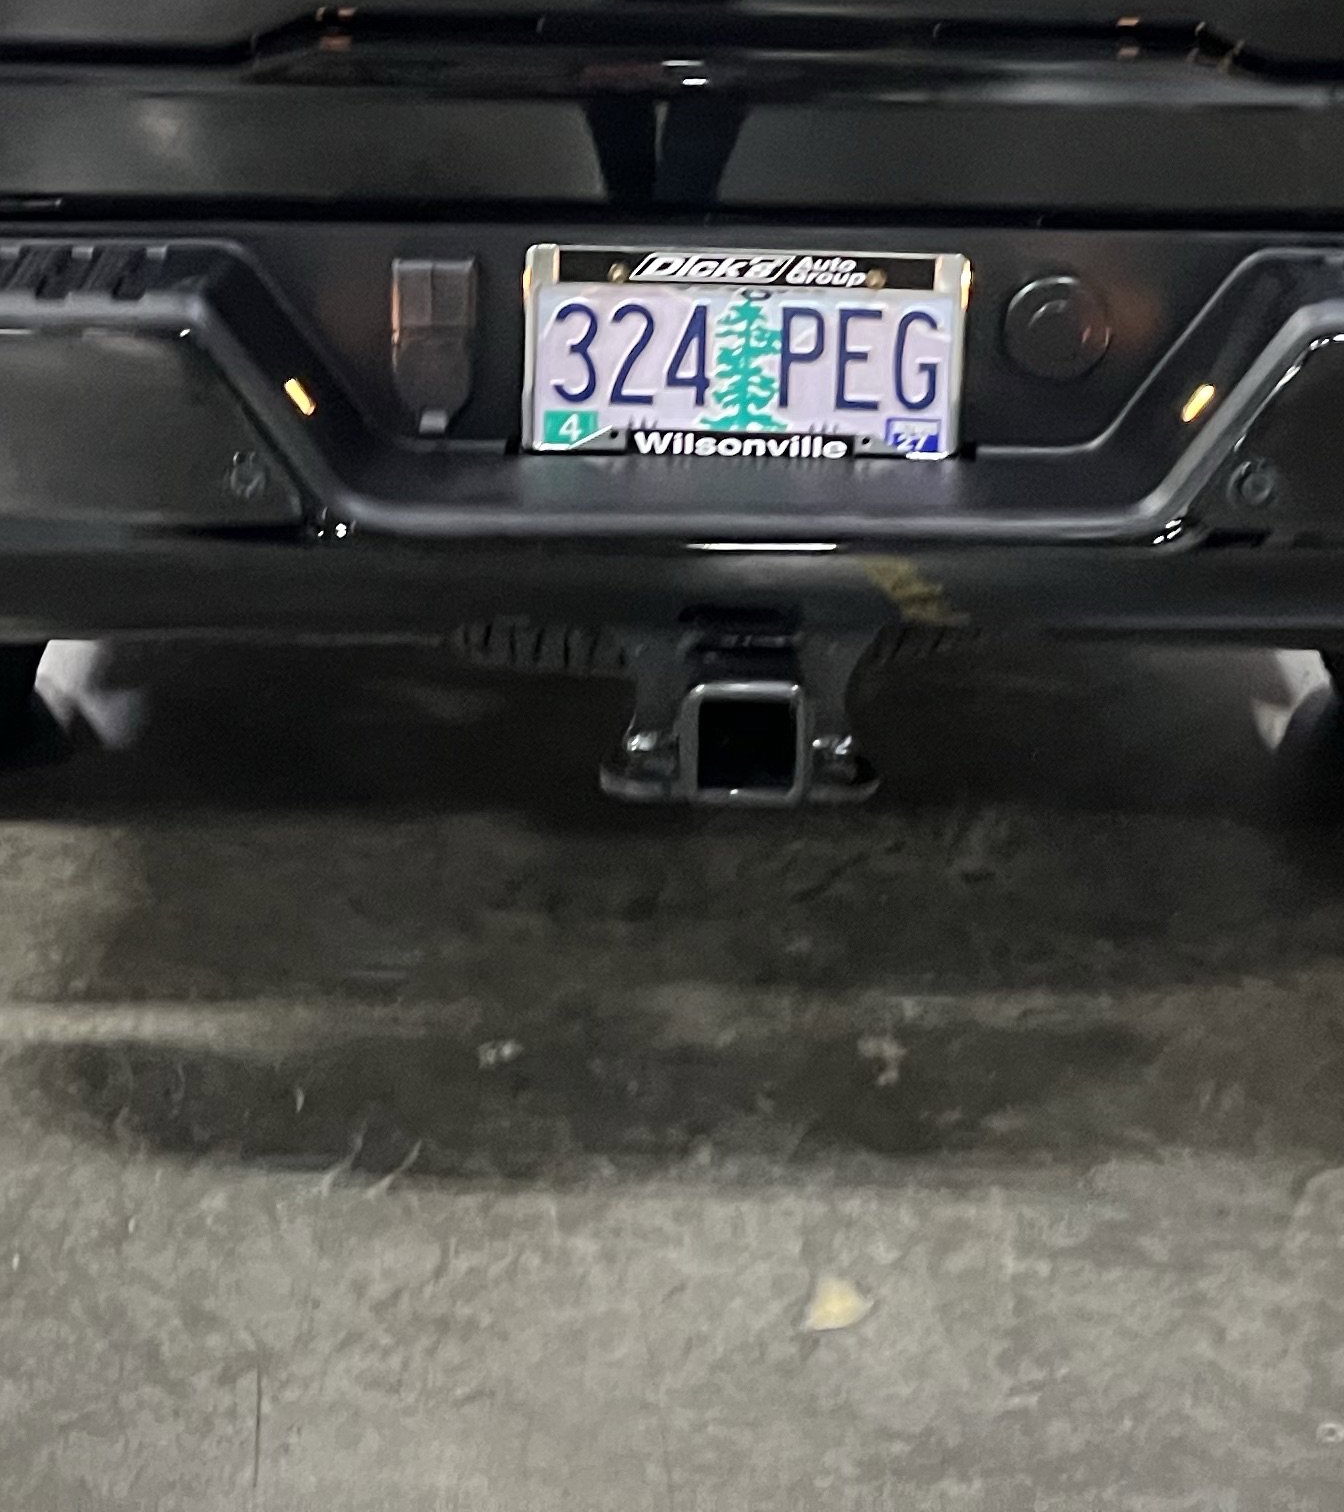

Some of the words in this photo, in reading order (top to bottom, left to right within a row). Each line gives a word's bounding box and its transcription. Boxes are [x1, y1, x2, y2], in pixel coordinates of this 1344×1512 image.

[796, 255, 857, 272] Auto
[785, 270, 867, 287] Group
[554, 302, 710, 408] 324
[777, 306, 940, 412] PEG
[558, 413, 583, 442] 4
[633, 430, 848, 459] Wilsonville
